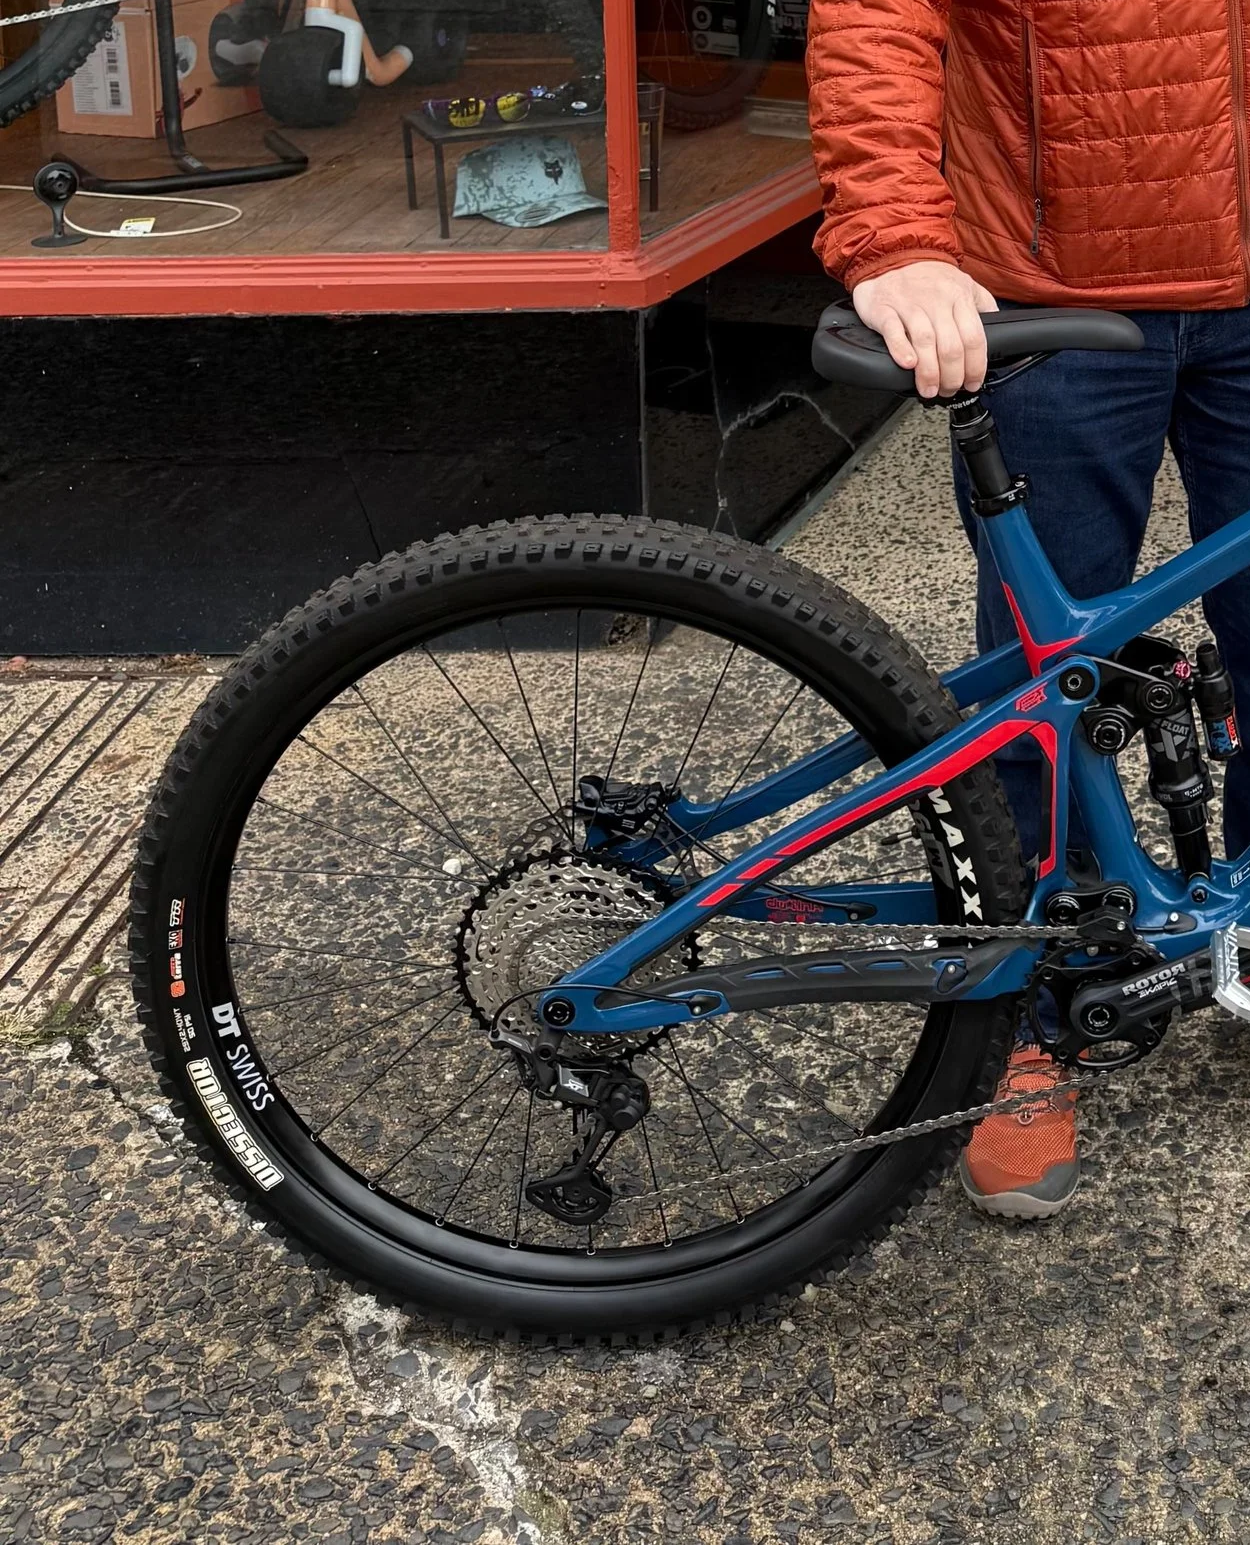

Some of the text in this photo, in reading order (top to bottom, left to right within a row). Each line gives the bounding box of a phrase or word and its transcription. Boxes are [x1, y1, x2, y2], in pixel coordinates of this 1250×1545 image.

[1161, 719, 1191, 736] FLOAT
[1121, 962, 1187, 996] ROTOR
[212, 1001, 276, 1112] DT SWISS
[186, 1056, 286, 1192] DISSECTOR
